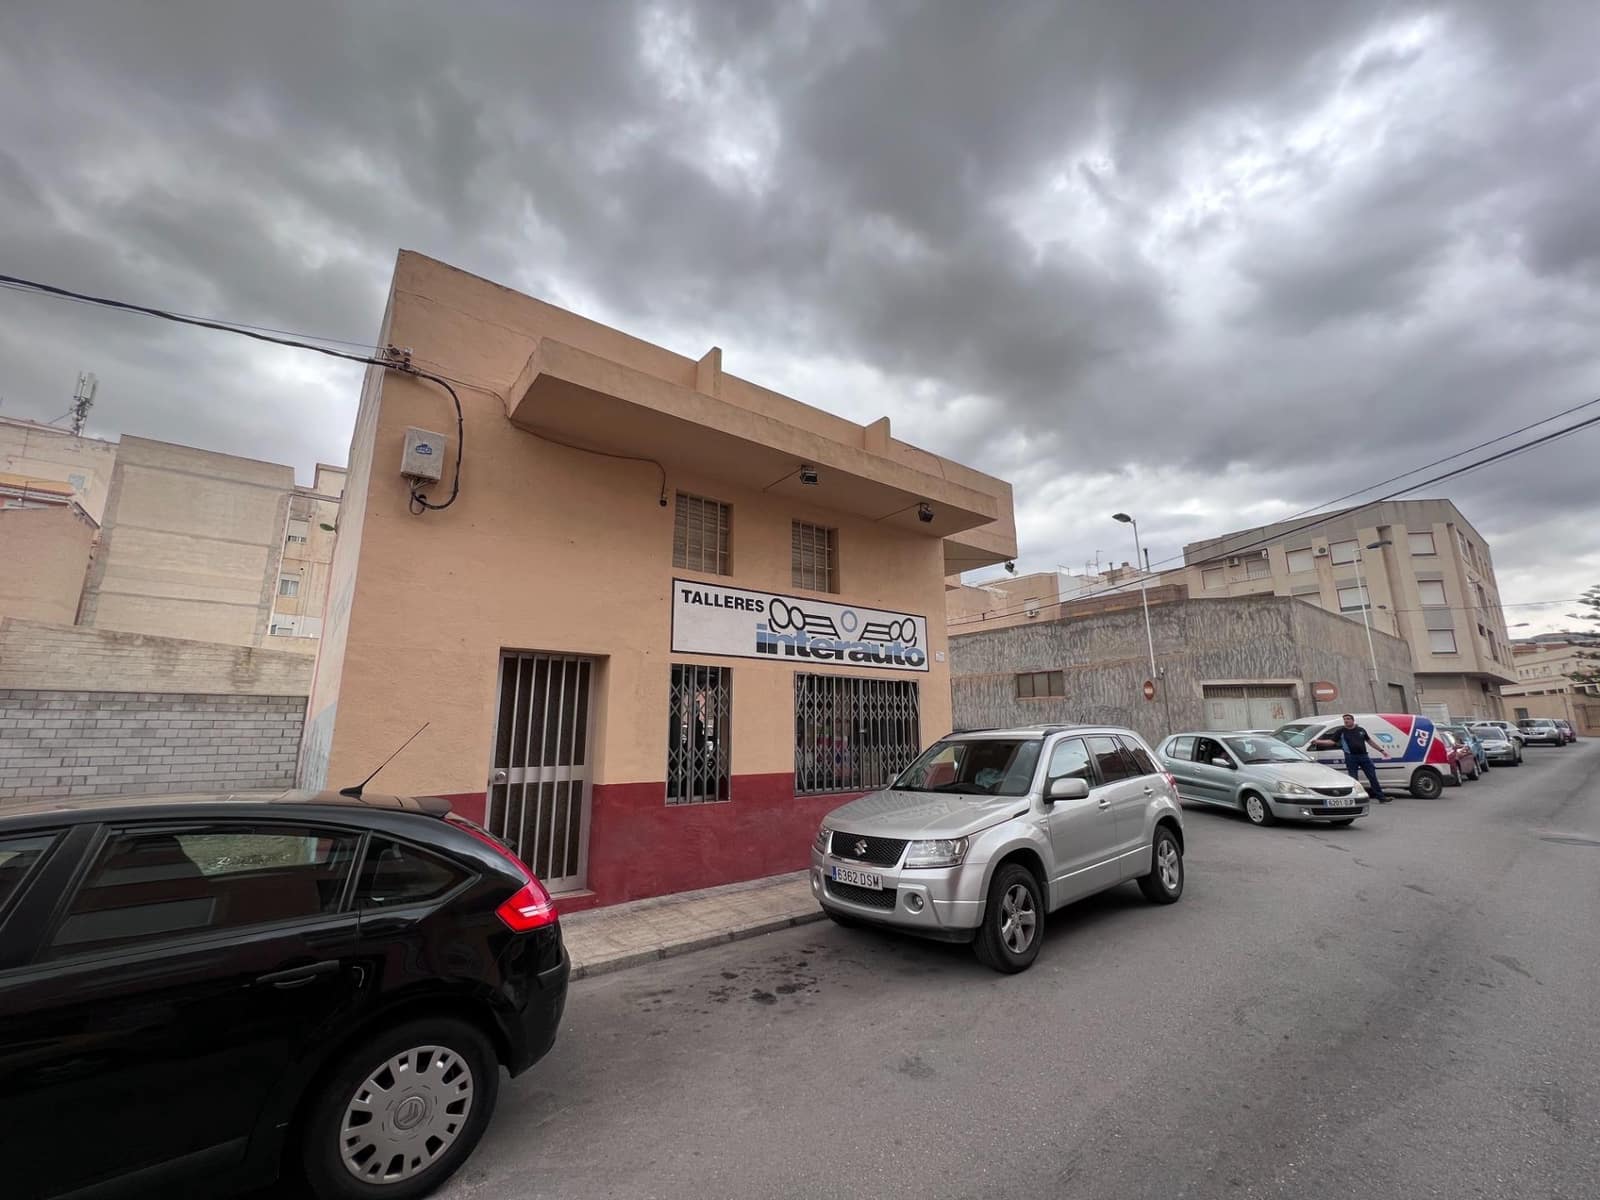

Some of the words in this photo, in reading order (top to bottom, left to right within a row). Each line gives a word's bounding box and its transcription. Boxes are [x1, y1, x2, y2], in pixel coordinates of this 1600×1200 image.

[681, 589, 764, 613] TALLERES
[756, 623, 925, 667] interauto
[837, 868, 858, 884] 6362
[860, 872, 880, 888] DSM
